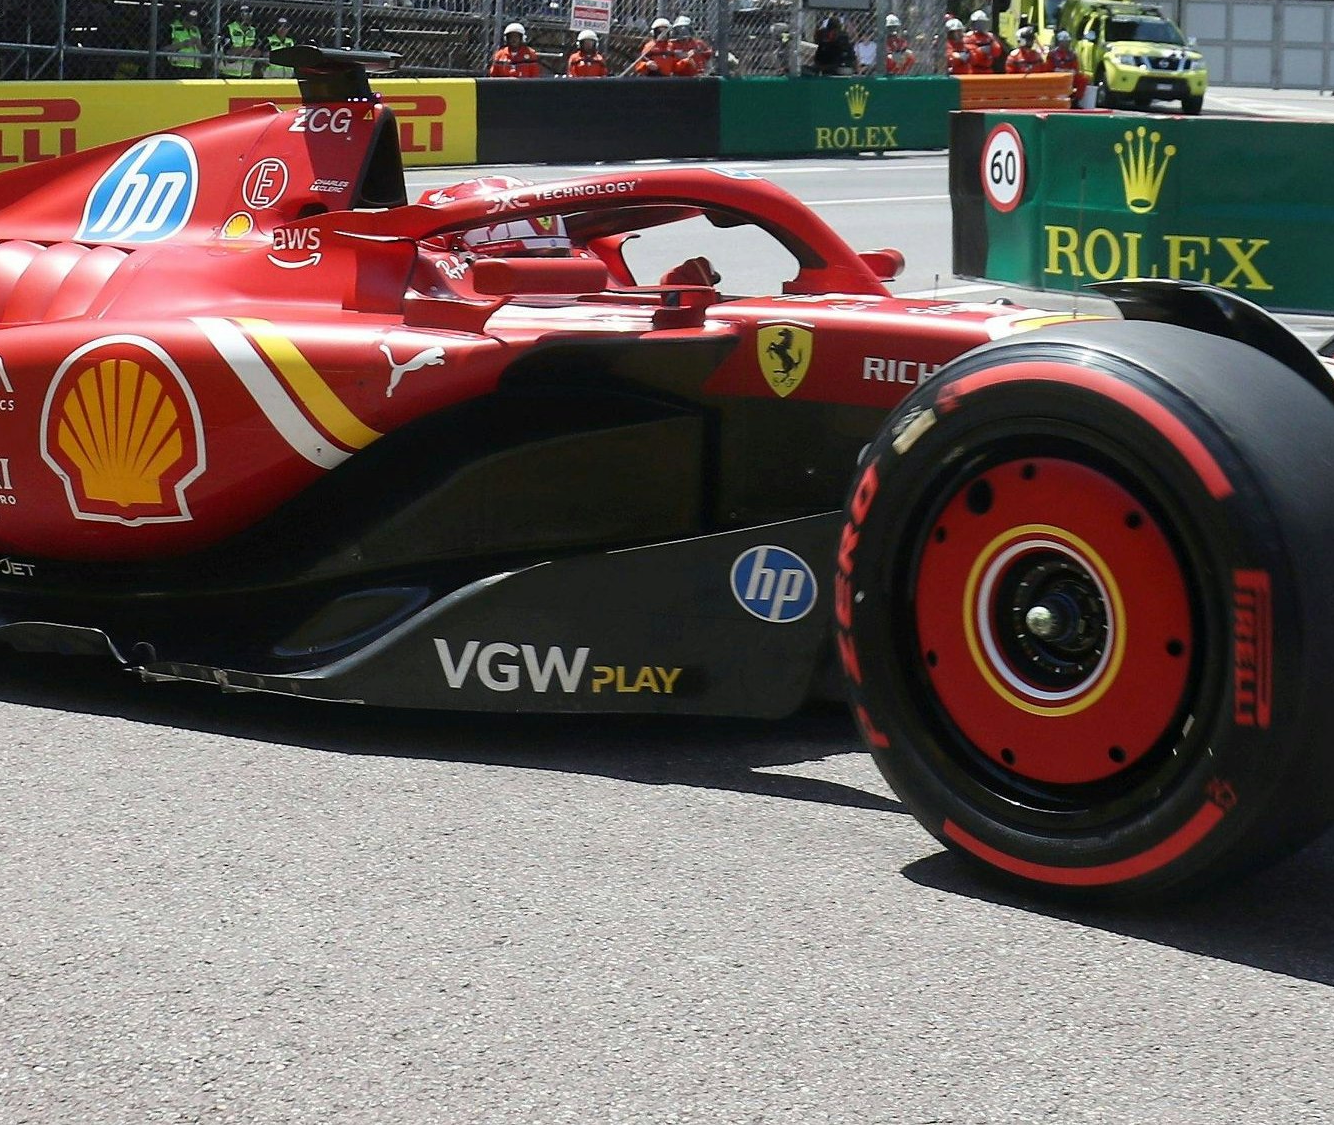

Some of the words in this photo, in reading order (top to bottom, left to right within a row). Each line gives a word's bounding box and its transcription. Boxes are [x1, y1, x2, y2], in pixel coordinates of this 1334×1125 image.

[815, 125, 898, 149] ROLEX
[89, 138, 188, 242] hp
[990, 149, 1017, 186] 60
[534, 181, 637, 201] TECHNOLOGY
[273, 227, 321, 251] aws
[1043, 225, 1274, 291] ROLEX
[745, 545, 806, 622] hp
[433, 638, 590, 694] VGW
[591, 665, 683, 694] PLAY
